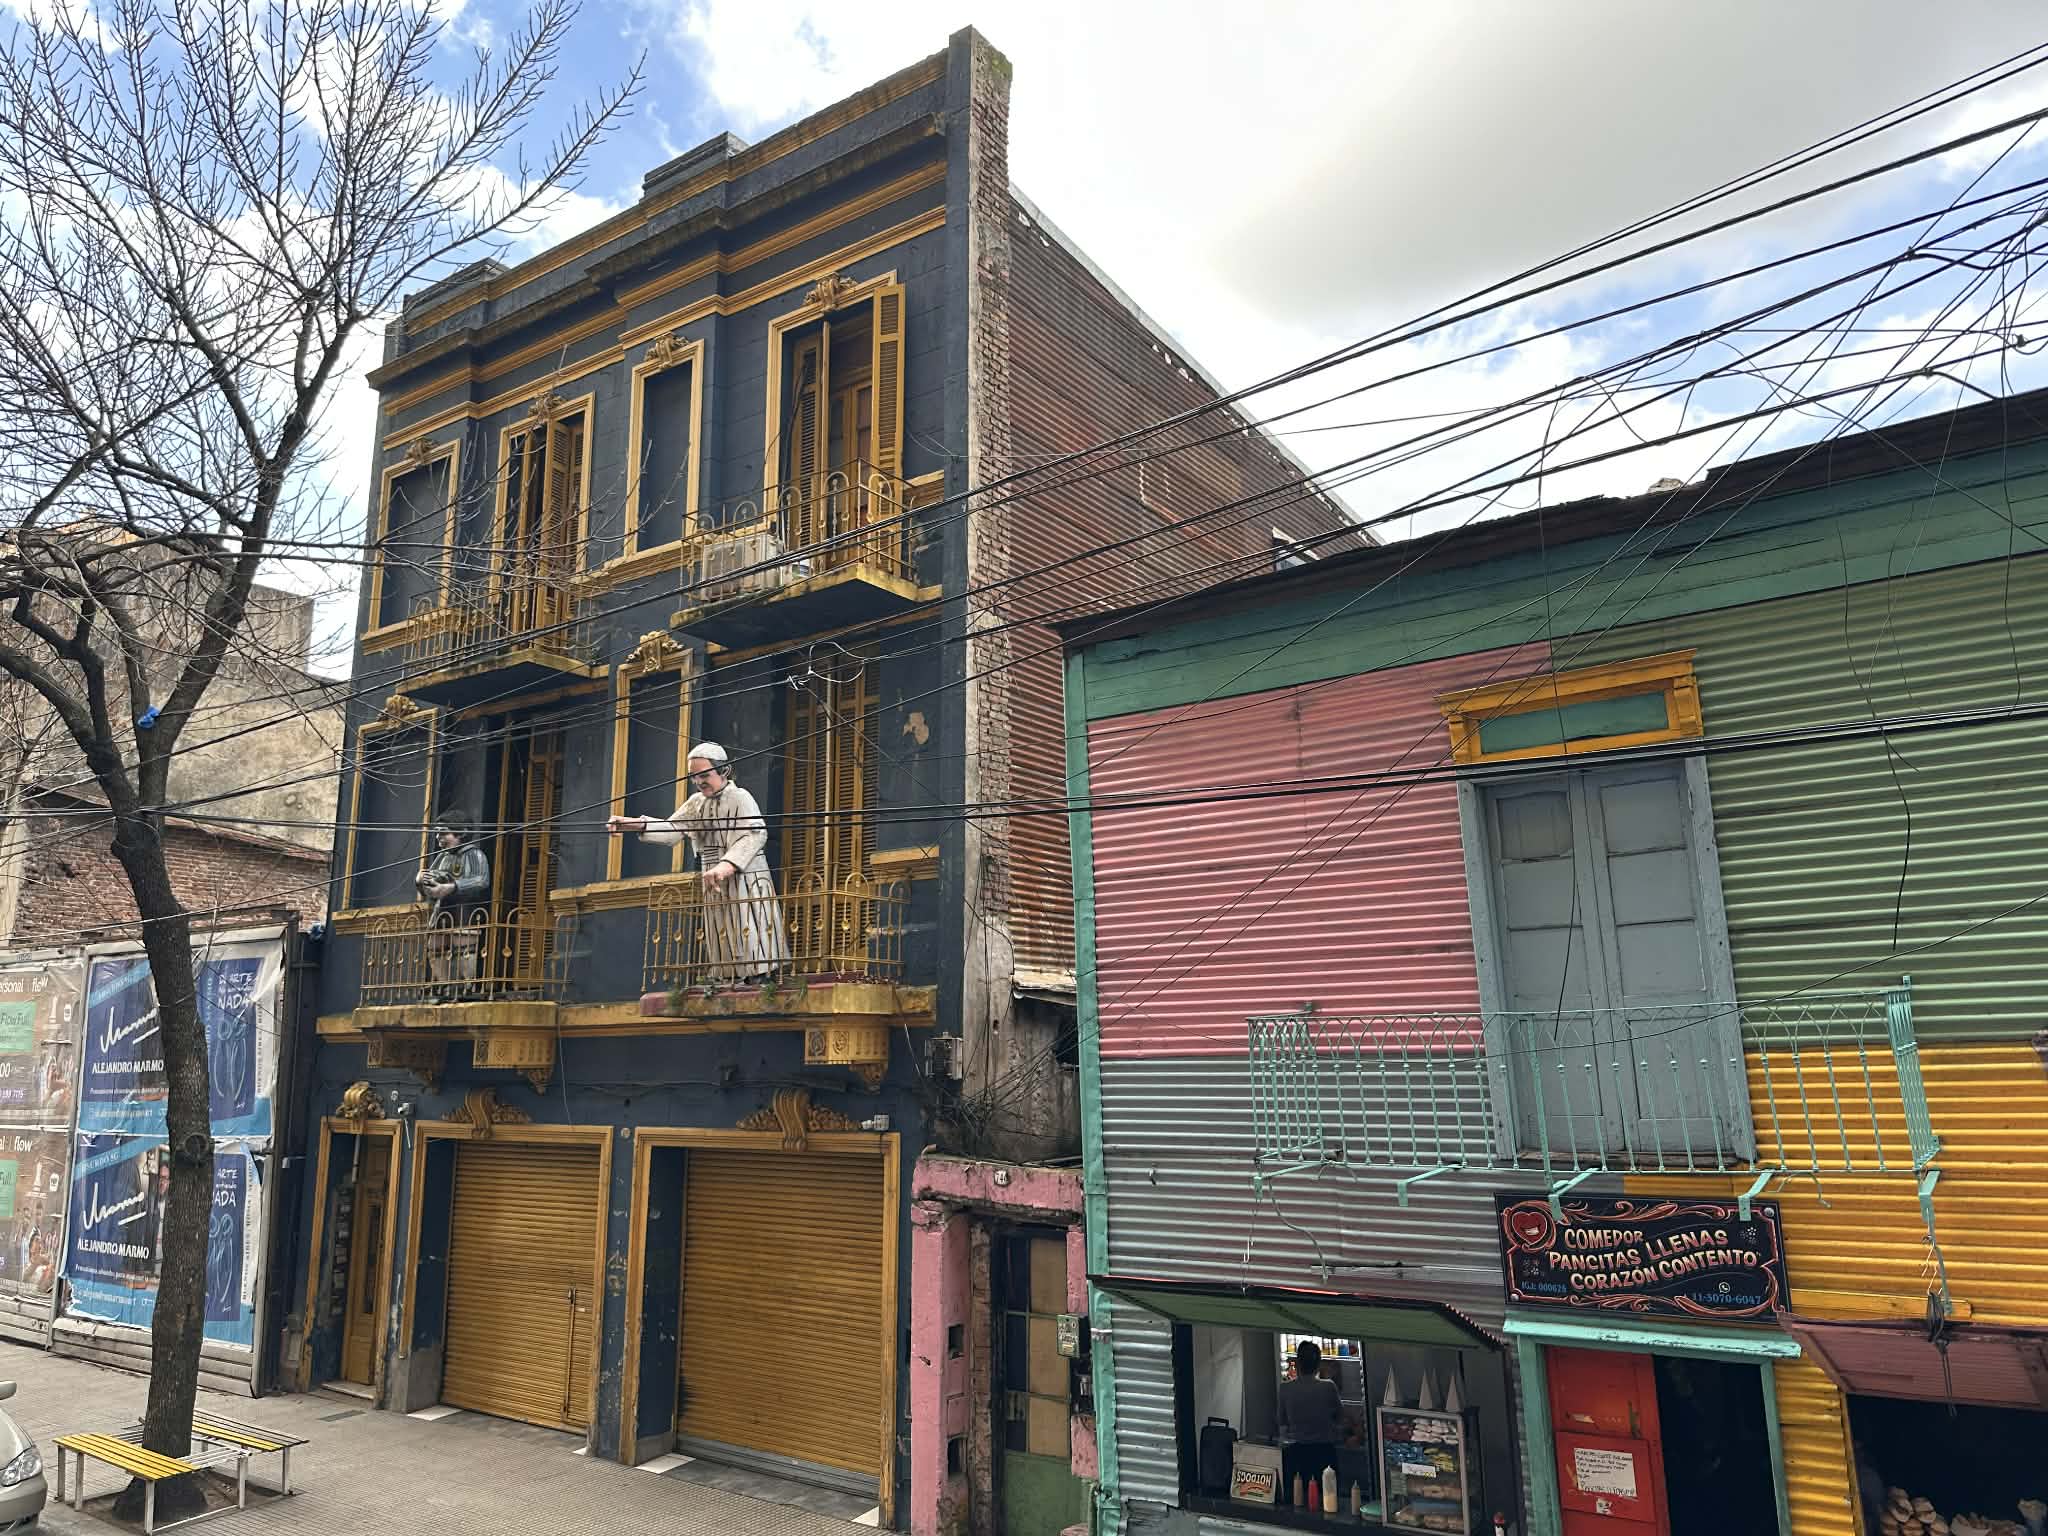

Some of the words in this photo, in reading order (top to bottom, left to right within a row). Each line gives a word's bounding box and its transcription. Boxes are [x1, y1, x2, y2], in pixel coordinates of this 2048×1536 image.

[92, 1059, 133, 1074] ALEJANDRO
[134, 1058, 165, 1073] MARMO
[77, 1238, 118, 1255] ALEJANDRO
[118, 1243, 150, 1259] MARMO
[1564, 1228, 1643, 1250] COMEDOR
[1645, 1229, 1729, 1260] LLENAS
[1570, 1266, 1659, 1290] CORAZÓN
